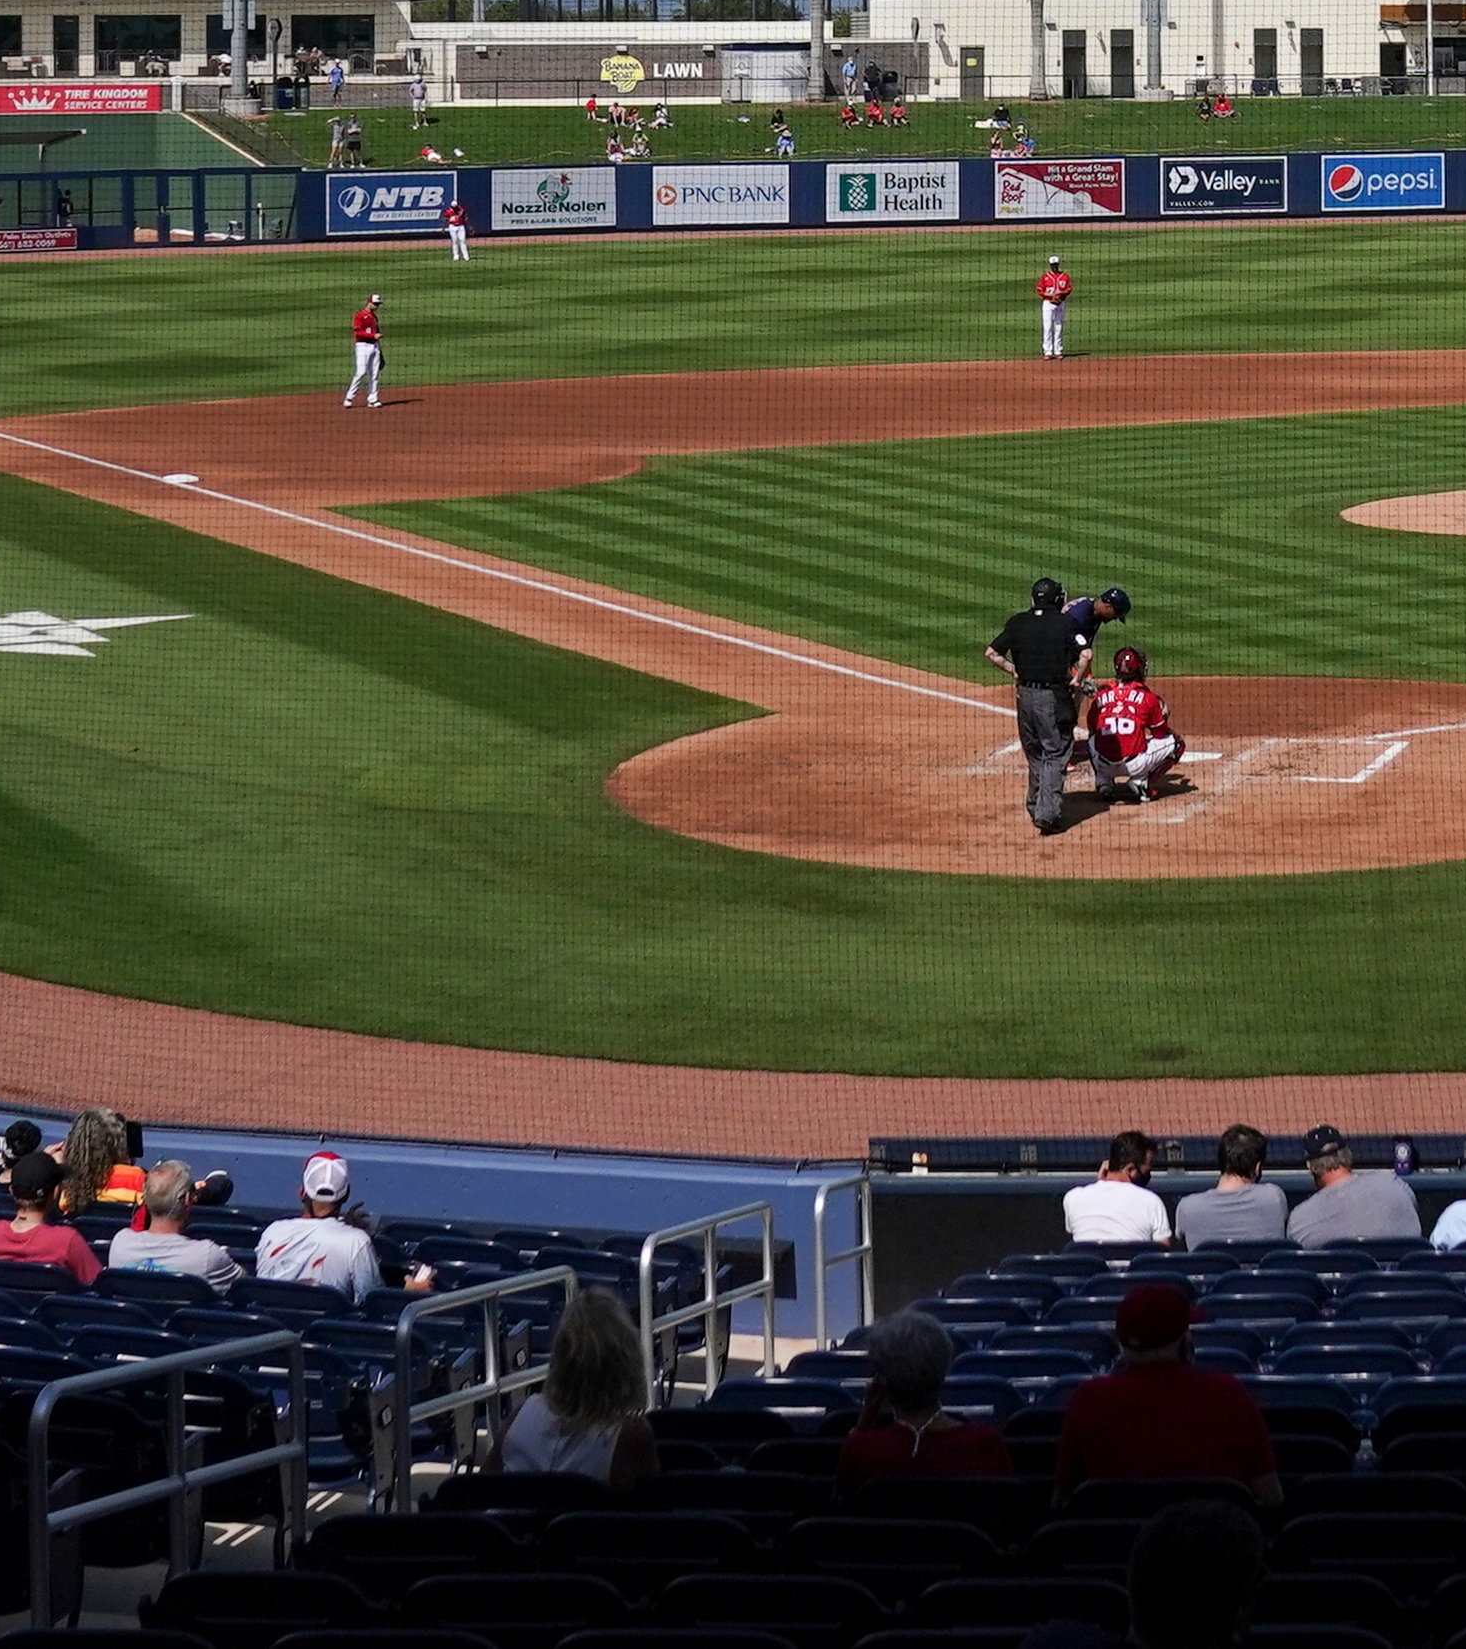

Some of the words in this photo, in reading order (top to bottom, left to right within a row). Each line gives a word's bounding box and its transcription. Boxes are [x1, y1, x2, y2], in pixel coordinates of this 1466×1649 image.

[653, 62, 703, 78] LAWN
[64, 89, 91, 99] TIRE
[93, 88, 149, 99] KINGDOM
[64, 100, 104, 110] SERVICE
[105, 100, 148, 109] CENTERS
[1047, 165, 1061, 173] Hit
[1067, 165, 1093, 173] Grand
[1094, 164, 1114, 172] Slam
[883, 172, 946, 190] Baptist
[1043, 173, 1064, 182] with
[1072, 173, 1096, 182] Great
[1097, 172, 1119, 182] Stay!
[1200, 169, 1257, 197] Valley
[1003, 180, 1022, 192] Red
[371, 187, 445, 209] NTB
[883, 192, 944, 212] Health
[1001, 190, 1026, 205] Roof
[501, 200, 607, 215] NozzleNolen
